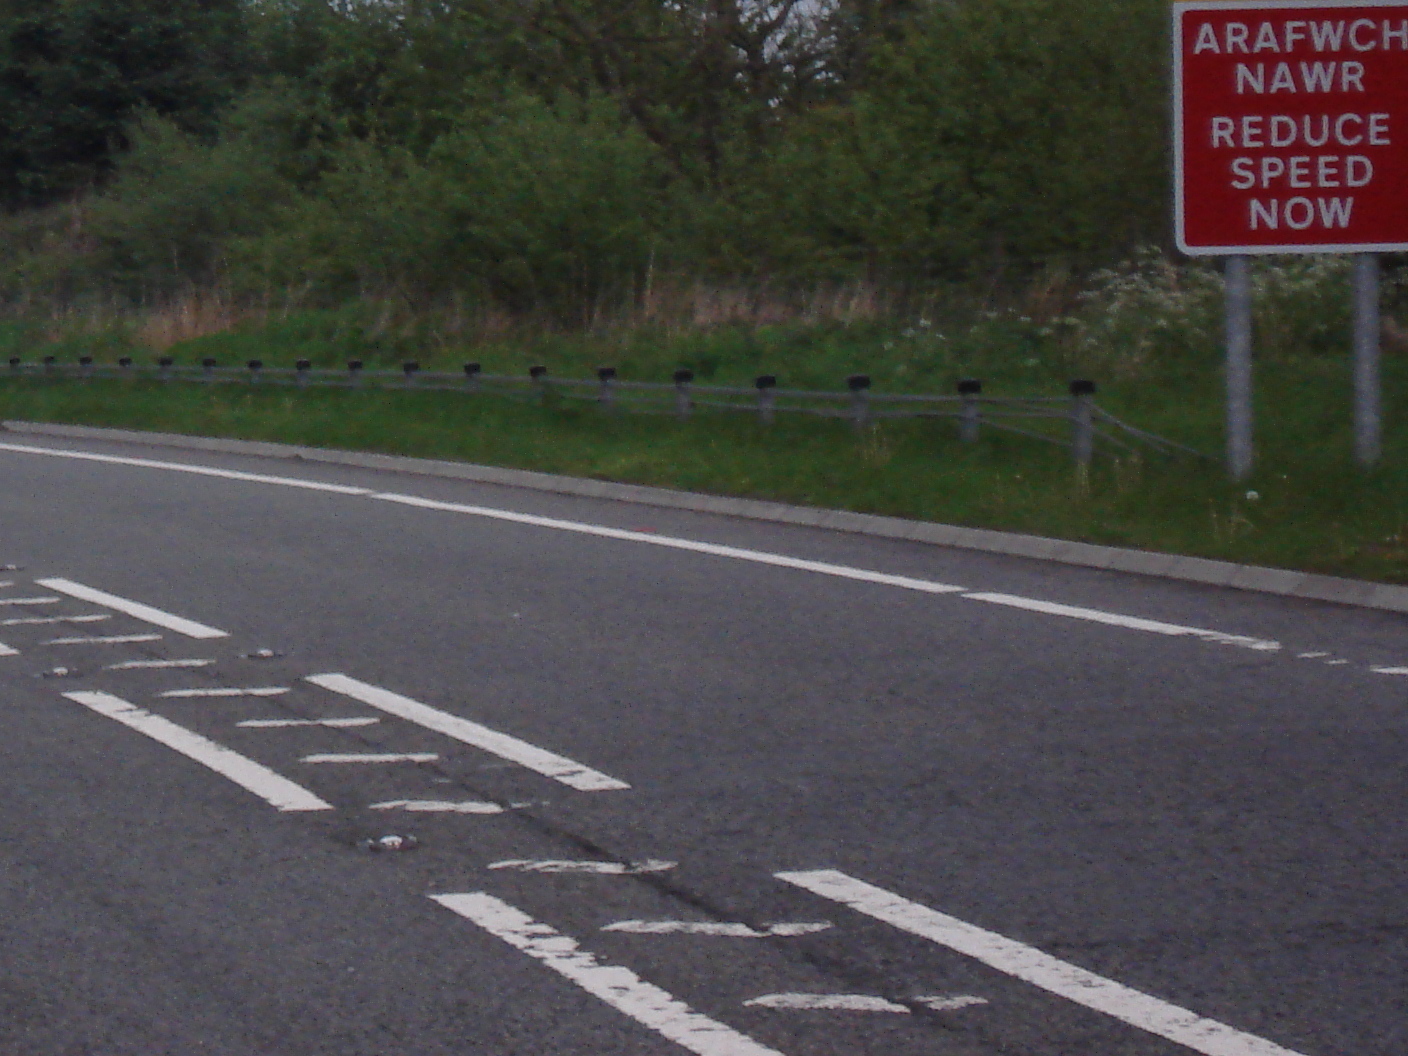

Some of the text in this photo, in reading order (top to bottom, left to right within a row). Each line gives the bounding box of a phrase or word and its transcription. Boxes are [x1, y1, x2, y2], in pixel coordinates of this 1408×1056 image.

[1194, 18, 1408, 54] ARAFWCH
[1236, 60, 1365, 94] NAWR
[1212, 113, 1391, 148] REDUCE
[1230, 155, 1374, 190] SPEED
[1249, 196, 1354, 231] NOW
